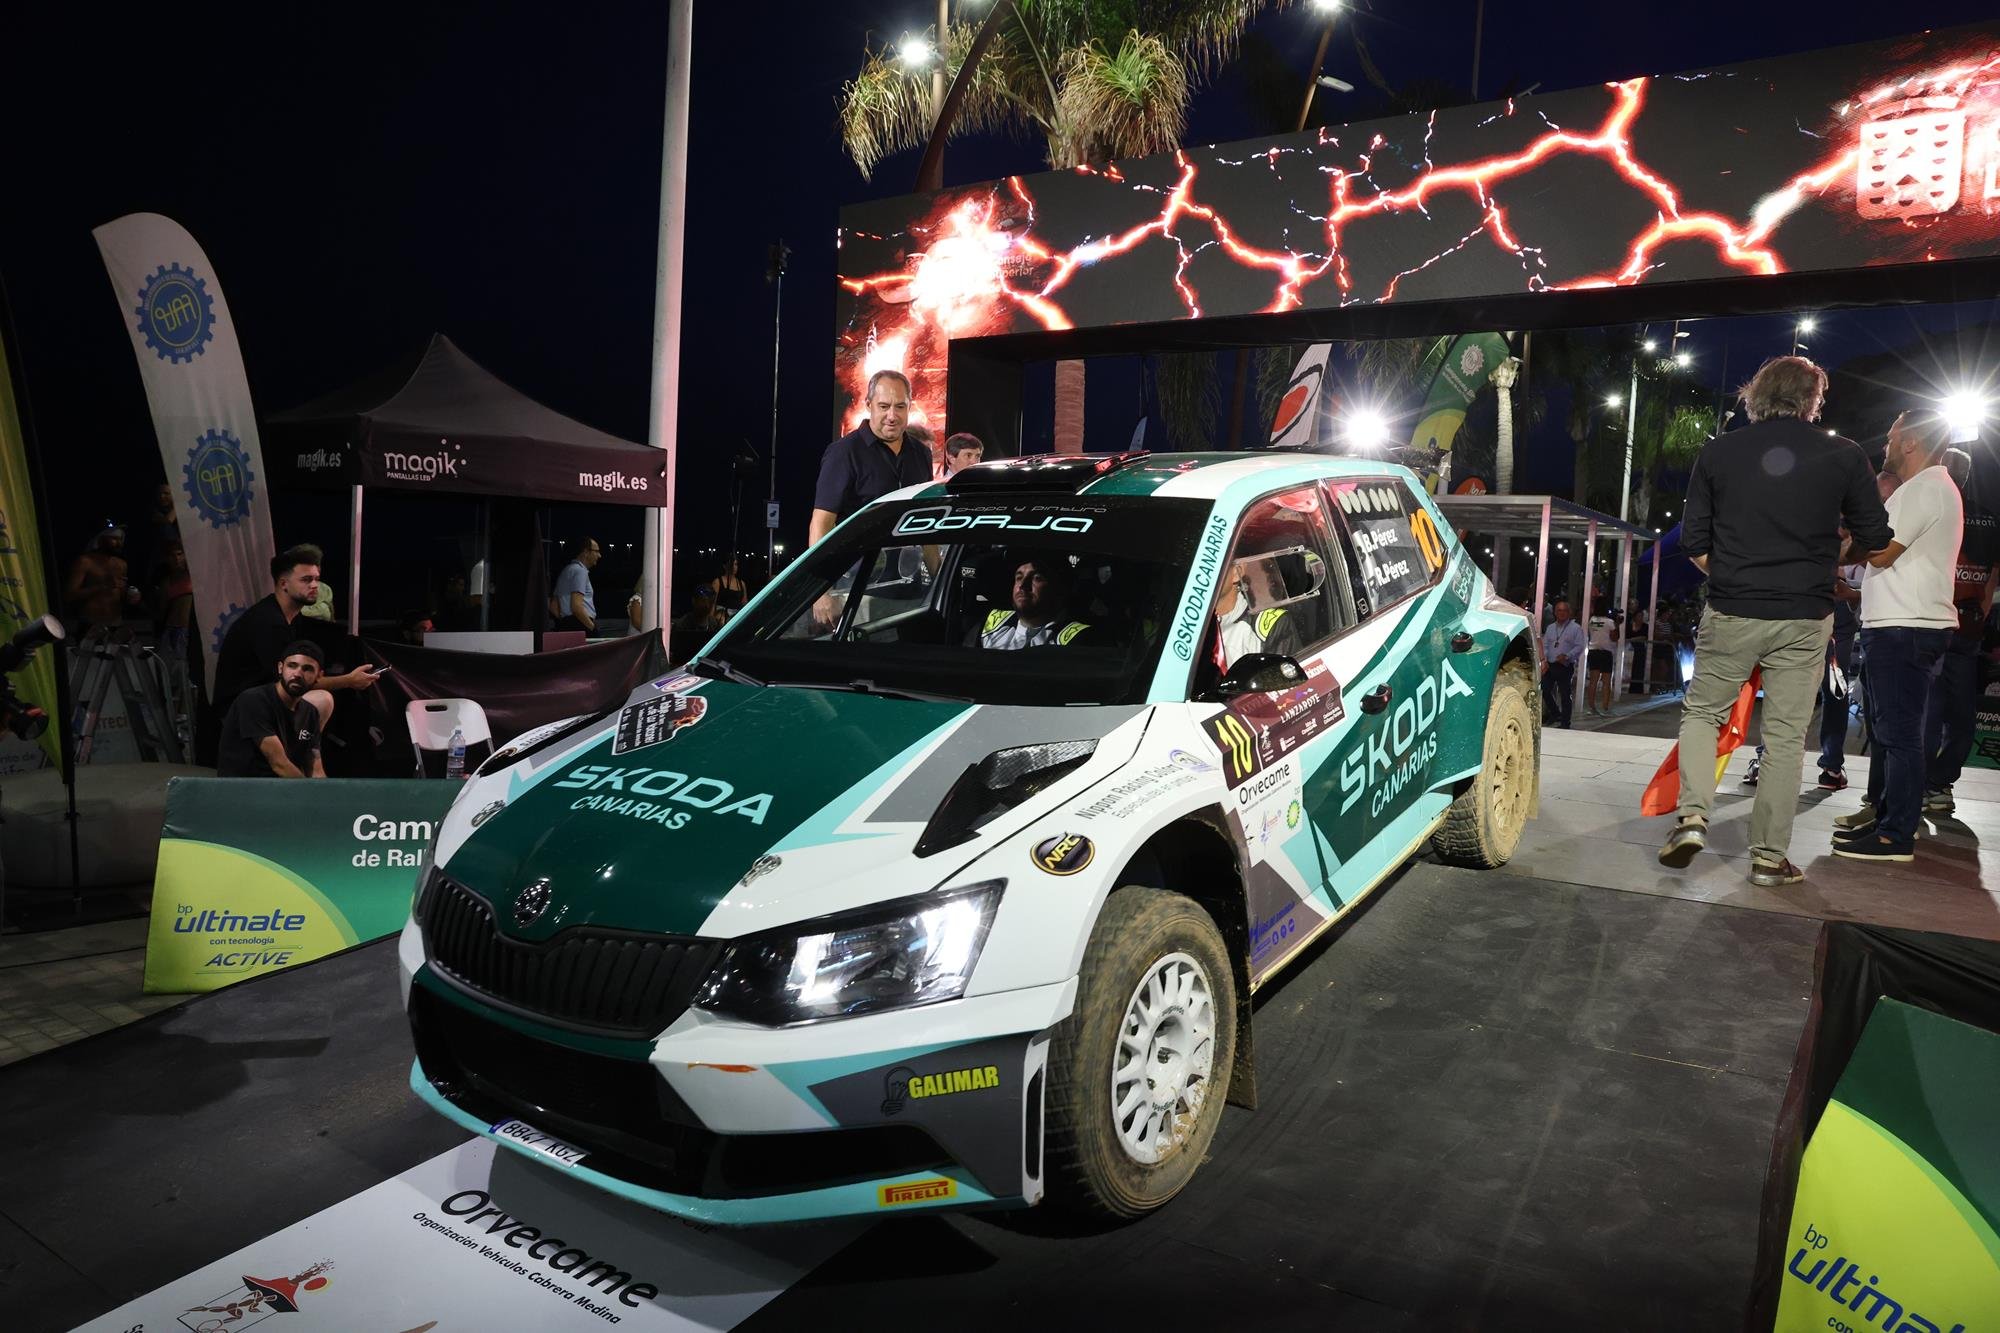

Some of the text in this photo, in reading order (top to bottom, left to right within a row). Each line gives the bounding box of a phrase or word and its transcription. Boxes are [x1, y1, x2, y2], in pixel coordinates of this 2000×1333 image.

[297, 448, 342, 472] magik.es
[384, 451, 457, 478] magik
[386, 471, 419, 481] PANTALLAS
[579, 471, 648, 491] magik.es
[1966, 518, 1996, 527] ZAROTE
[1361, 528, 1398, 553] B.Pérez
[1410, 508, 1443, 573] 10
[1375, 559, 1410, 586] R.Pérez
[1173, 515, 1227, 661] @SKODACANARIAS
[1280, 693, 1321, 723] LANZAROTE
[1215, 714, 1253, 779] 10
[1239, 763, 1290, 805] Orvecame
[1372, 731, 1437, 818] CANARIAS
[1074, 793, 1122, 820] Nippon
[1112, 775, 1160, 796] Racing
[570, 794, 692, 829] CANARIAS
[352, 814, 439, 840] Cam
[352, 849, 380, 867] de
[1045, 834, 1080, 869] NRC
[174, 909, 305, 933] ultimate
[177, 904, 193, 916] bp
[209, 935, 275, 946] con tecnología
[205, 951, 293, 967] ACTIVE
[908, 1065, 999, 1099] GALIMAR
[503, 1123, 580, 1162] 8847 KGZ
[885, 1181, 949, 1204] PIRELLI
[441, 1189, 659, 1308] Orvecame
[1803, 1224, 1828, 1250] bp
[413, 1211, 622, 1325] Organización Vehículos Cabrera Medina
[1788, 1248, 1966, 1333] ultima
